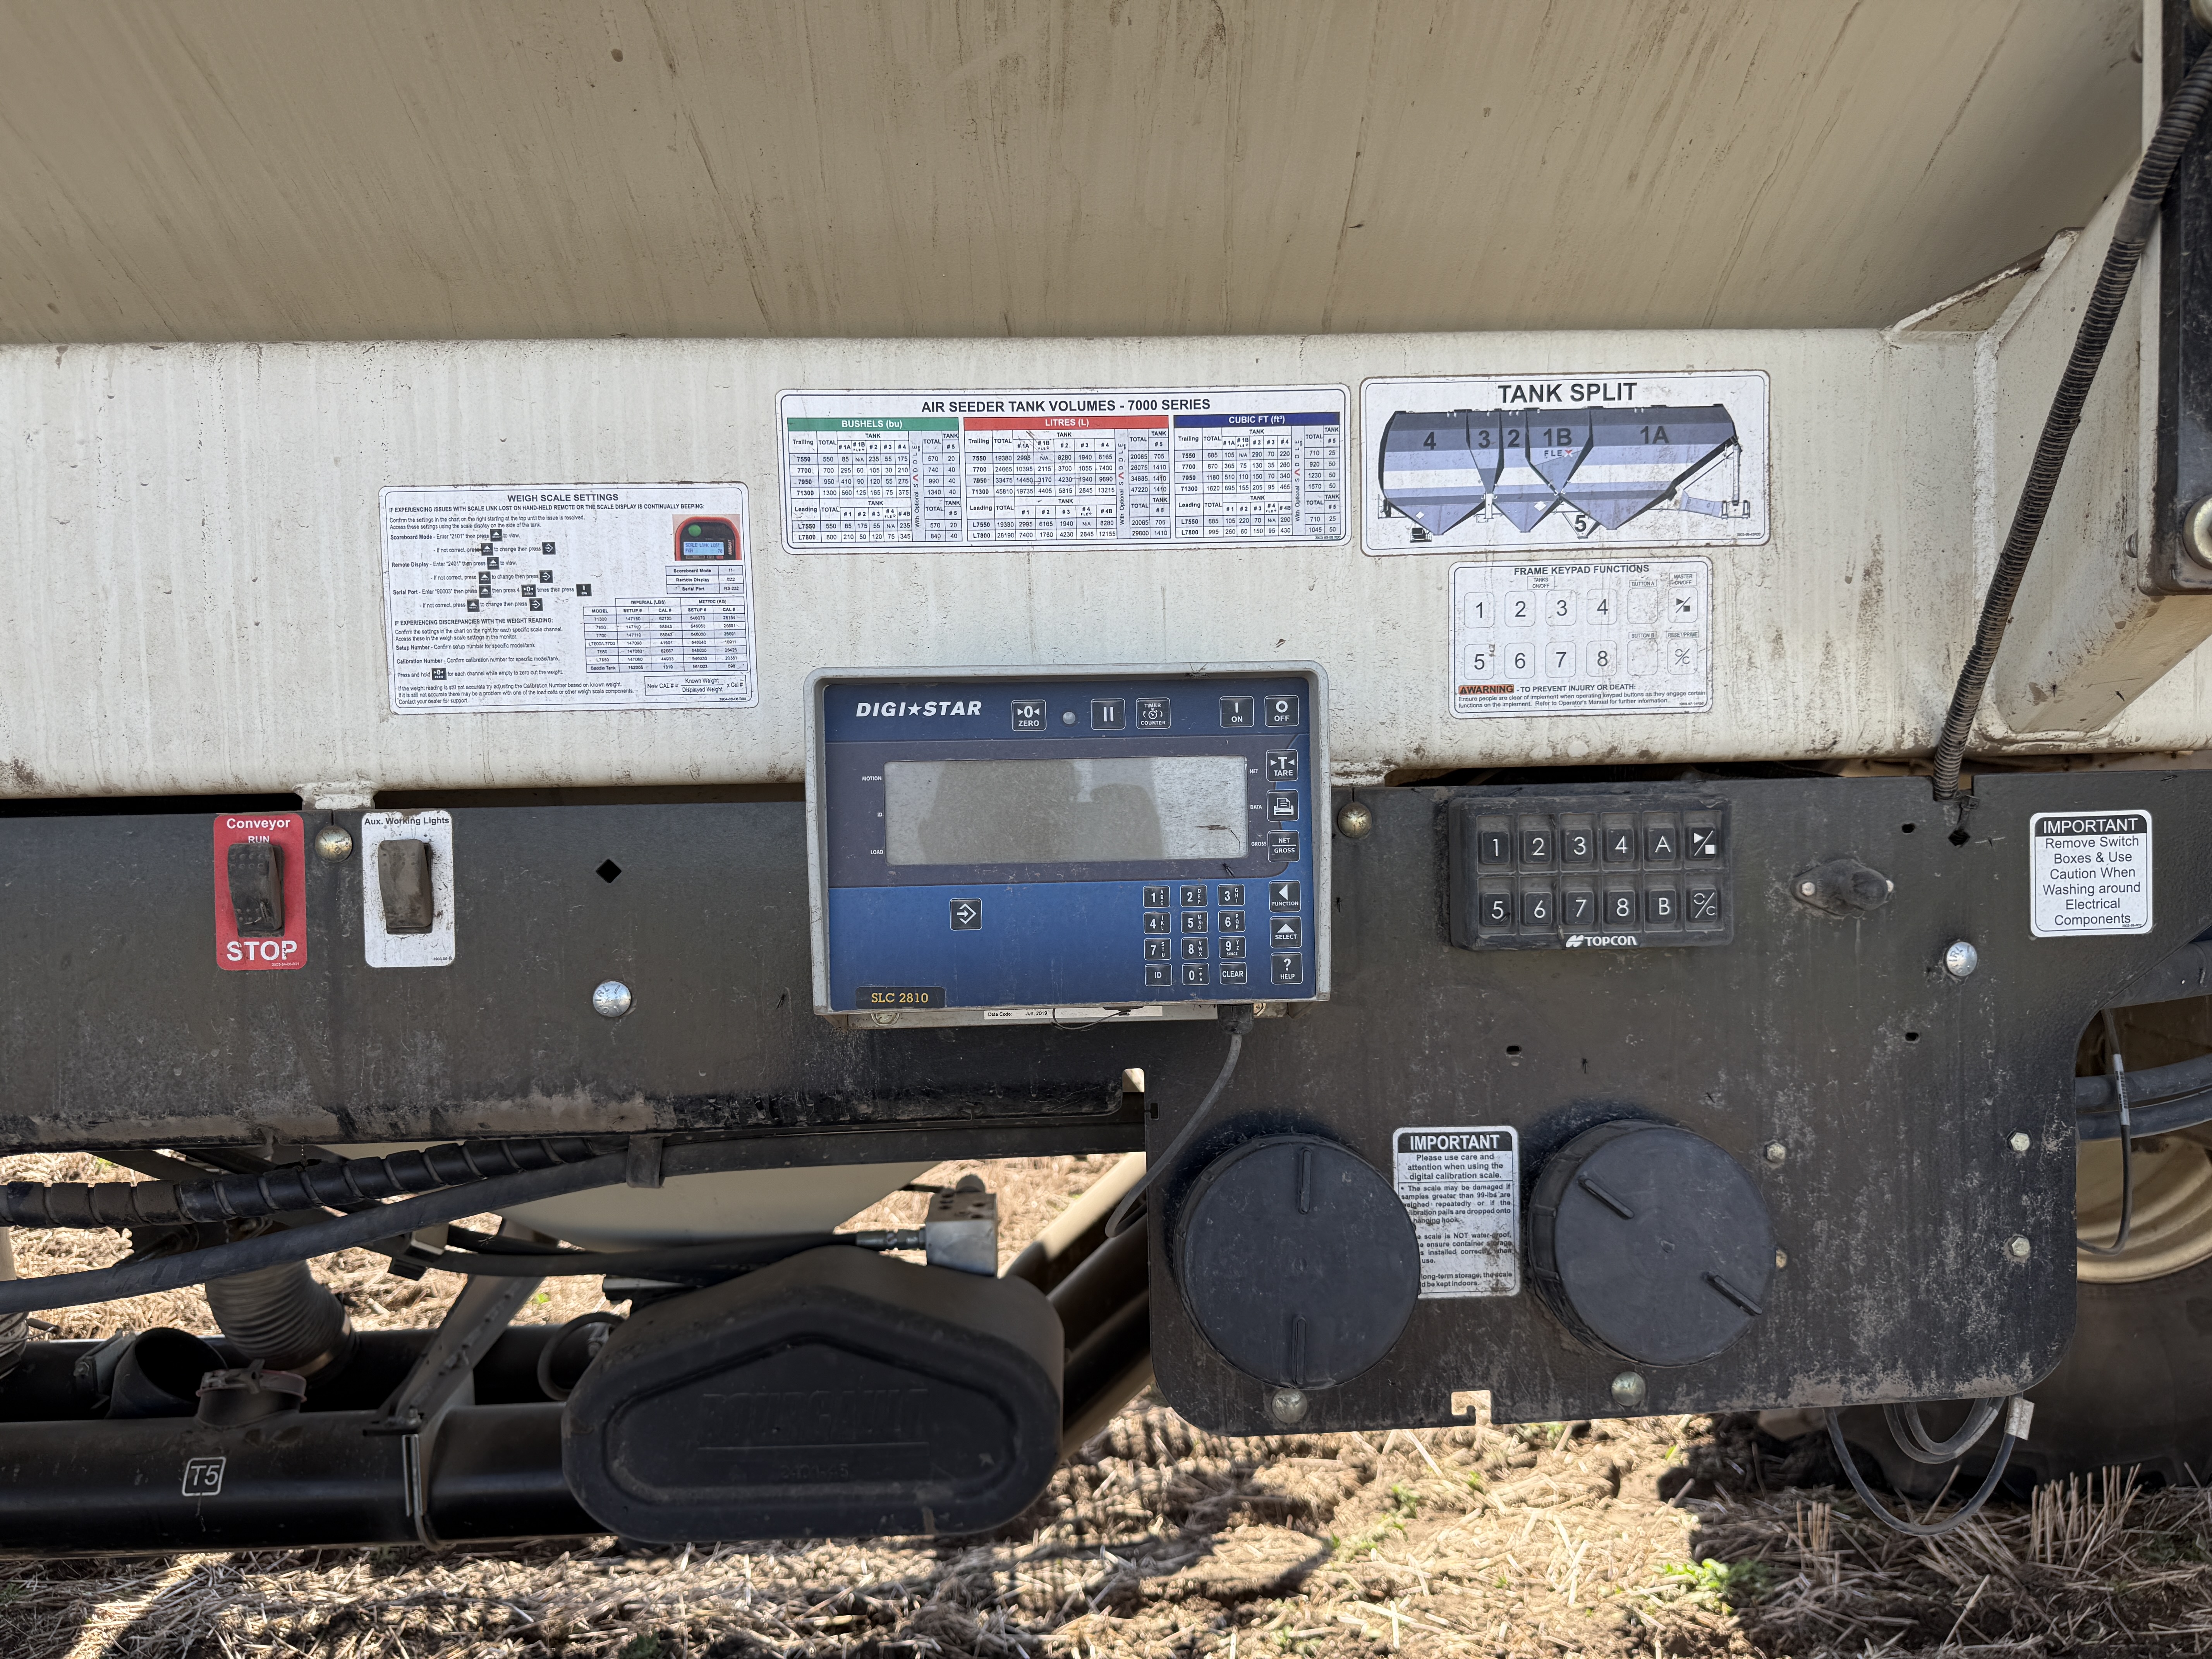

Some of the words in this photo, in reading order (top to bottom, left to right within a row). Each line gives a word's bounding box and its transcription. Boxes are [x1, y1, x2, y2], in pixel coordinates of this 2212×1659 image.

[1498, 384, 1562, 403] TANK
[1570, 383, 1637, 402] SPLIT
[922, 402, 945, 412] AIR
[949, 402, 1005, 412] SEEDER
[1008, 401, 1045, 412] TANK
[1049, 400, 1115, 411] VOLUMES
[1128, 400, 1157, 410] 7000
[1162, 399, 1210, 410] SERIES
[886, 420, 902, 429] (bu)
[1079, 419, 1089, 428] (L)
[1424, 432, 1436, 450] 4
[1478, 430, 1490, 448] 3
[1508, 429, 1520, 447] 2
[1543, 428, 1572, 447] 1B
[1640, 426, 1669, 444] 1A
[1544, 449, 1573, 458] FLEX
[1575, 514, 1587, 531] 5
[1594, 565, 1649, 573] FUNCTIONS
[1476, 602, 1482, 618] 1
[1515, 601, 1526, 617] 2
[1557, 600, 1567, 616] 3
[1597, 599, 1608, 615] 4
[1474, 654, 1484, 670] 5
[1515, 653, 1525, 669] 6
[1556, 652, 1566, 668] 7
[1597, 651, 1608, 666] 8
[1467, 685, 1513, 694] WARNING
[1278, 757, 1287, 769] T
[227, 818, 290, 830] Conveyor
[424, 817, 449, 825] Lights
[2044, 818, 2138, 833] IMPORTANT
[1493, 839, 1498, 856] 1
[1533, 838, 1544, 855] 2
[1574, 837, 1586, 855] 3
[1615, 836, 1627, 853] 4
[1655, 836, 1671, 852] A
[2046, 838, 2095, 848] Remove
[2100, 835, 2138, 847] Switch
[2054, 854, 2091, 864] Boxes
[2096, 852, 2104, 862] &
[2109, 852, 2132, 862] Use
[2051, 869, 2096, 879] Caution
[2100, 867, 2135, 878] When
[1224, 891, 1230, 901] 3
[2043, 884, 2094, 896] Washing
[2099, 882, 2140, 893] around
[1151, 893, 1155, 902] 1
[1187, 892, 1193, 902] 2
[2066, 898, 2120, 910] Electrical
[1492, 901, 1504, 919] 5
[1534, 900, 1545, 918] 6
[1576, 900, 1587, 917] 7
[1617, 898, 1629, 916] 8
[1659, 898, 1670, 915] B
[1150, 919, 1156, 929] 4
[1188, 918, 1193, 928] 5
[1225, 917, 1231, 927] 6
[2055, 914, 2131, 927] Components
[1226, 941, 1231, 951] 9
[1584, 936, 1637, 946] TOPCON
[227, 941, 297, 961] STOP
[1151, 945, 1156, 955] 7
[1188, 944, 1194, 954] 8
[1189, 970, 1194, 980] 0
[872, 993, 895, 1003] SLC
[899, 993, 928, 1003] 2810
[1410, 1135, 1499, 1150] IMPORTANT
[1468, 1163, 1489, 1171] using
[1410, 1173, 1433, 1181] digital
[191, 1465, 220, 1486] T5
